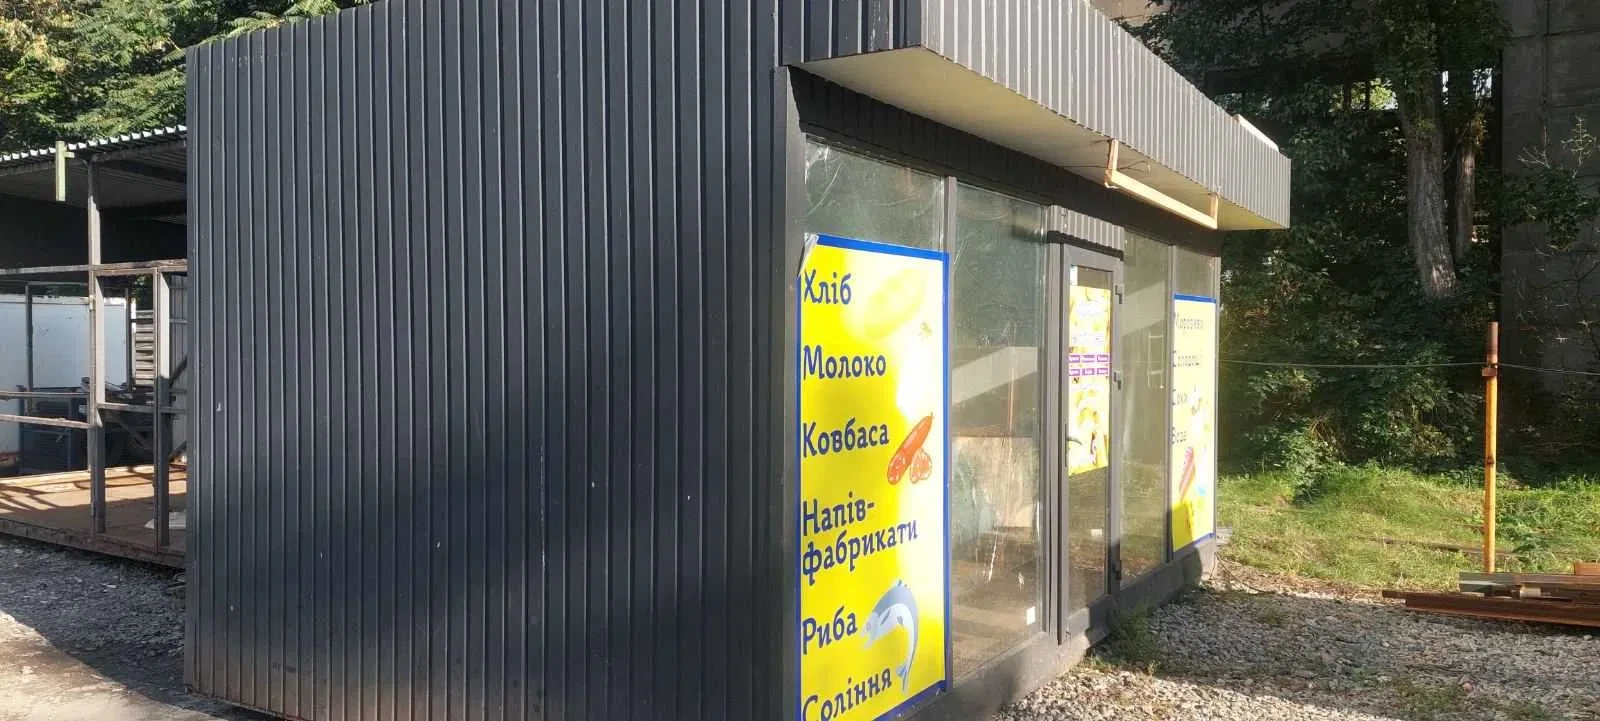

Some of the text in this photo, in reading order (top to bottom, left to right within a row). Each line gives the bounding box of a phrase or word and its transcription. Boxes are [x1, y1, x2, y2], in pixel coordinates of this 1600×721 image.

[803, 269, 852, 304] Хліб
[803, 345, 886, 380] Молоко
[803, 418, 890, 457] Ковбаса
[803, 491, 875, 536] Напів-
[803, 520, 919, 585] фабрикати
[803, 606, 858, 655] Риба
[803, 668, 892, 721] Соління
